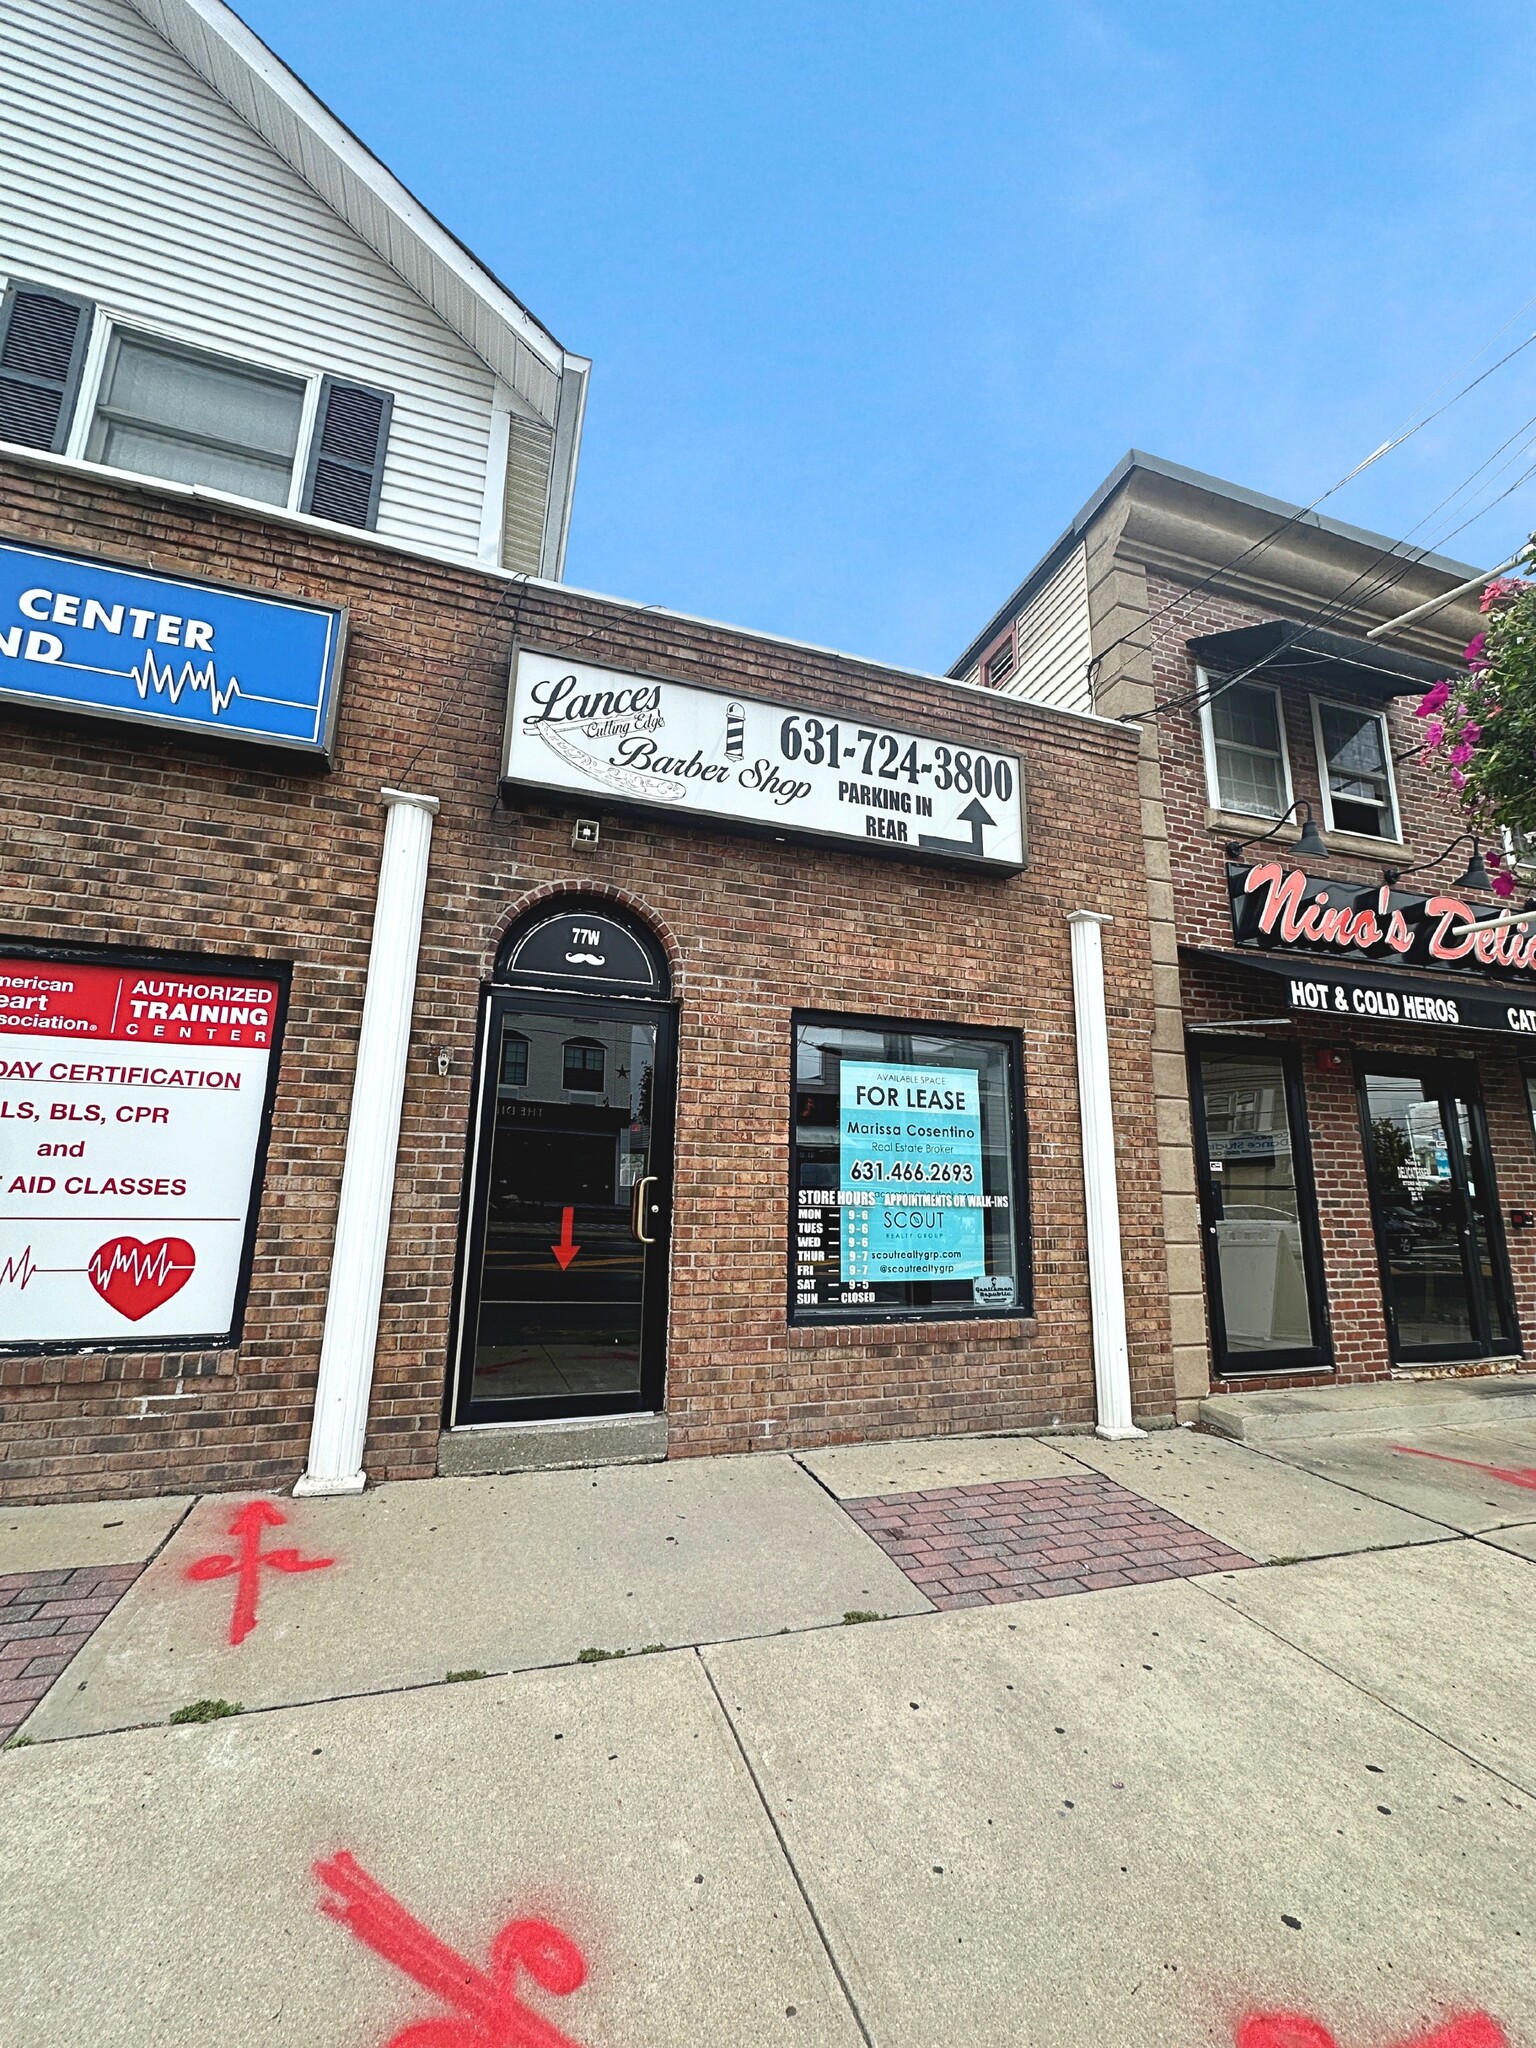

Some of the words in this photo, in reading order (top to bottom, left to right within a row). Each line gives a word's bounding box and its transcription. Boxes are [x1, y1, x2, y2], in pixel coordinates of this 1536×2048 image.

[18, 588, 215, 652] CENTER
[523, 676, 661, 723] Lances
[587, 719, 630, 739] Cutting
[634, 714, 665, 732] Edge
[780, 715, 1013, 802] 631-724-3800
[609, 736, 730, 783] Barber
[738, 759, 812, 805] Shop
[838, 781, 911, 814] PARKING
[915, 794, 933, 817] IN
[865, 814, 909, 842] REAR
[1244, 862, 1414, 952] Nino's
[571, 927, 600, 946] 77W
[131, 980, 273, 1004] AUTHORIZED
[1290, 980, 1329, 1009] HOT
[1334, 985, 1351, 1011] &
[1352, 988, 1400, 1017] COLD
[1403, 995, 1459, 1023] HEROS
[130, 1000, 268, 1026] TRAINING
[125, 1023, 266, 1042] CENTER
[49, 1062, 241, 1089] CERTIFICATION
[877, 1073, 919, 1083] AVAILABLE
[920, 1076, 946, 1085] SPACE
[856, 1086, 899, 1107] FOR
[906, 1088, 966, 1110] LEASE
[49, 1103, 107, 1125] BLS,
[115, 1106, 170, 1123] CPR
[847, 1121, 901, 1136] Marissa
[906, 1124, 975, 1139] Cosentino
[37, 1141, 85, 1158] and
[871, 1141, 893, 1152] Real
[895, 1142, 924, 1153] Estate
[926, 1145, 954, 1154] Broker
[851, 1160, 974, 1182] 631.466.2693
[7, 1175, 56, 1194] AID
[64, 1177, 187, 1196] CLASSES
[798, 1189, 836, 1205] STORE
[837, 1190, 876, 1206] HOURS
[884, 1193, 951, 1208] APPOINTMENTS
[953, 1195, 966, 1208] OR
[967, 1195, 1009, 1208] WALK-INS
[797, 1209, 821, 1220] MON
[883, 1211, 945, 1229] SCOUT
[797, 1222, 824, 1233] TUES
[797, 1236, 821, 1247] WED
[797, 1250, 825, 1262] THUR
[871, 1250, 962, 1261] scoutrealtygrp.com
[797, 1265, 814, 1276] FRI
[880, 1264, 955, 1274] @scoutrealtygrp
[797, 1279, 816, 1290] SAT
[797, 1293, 818, 1304] SUN
[841, 1291, 876, 1304] CLOSED
